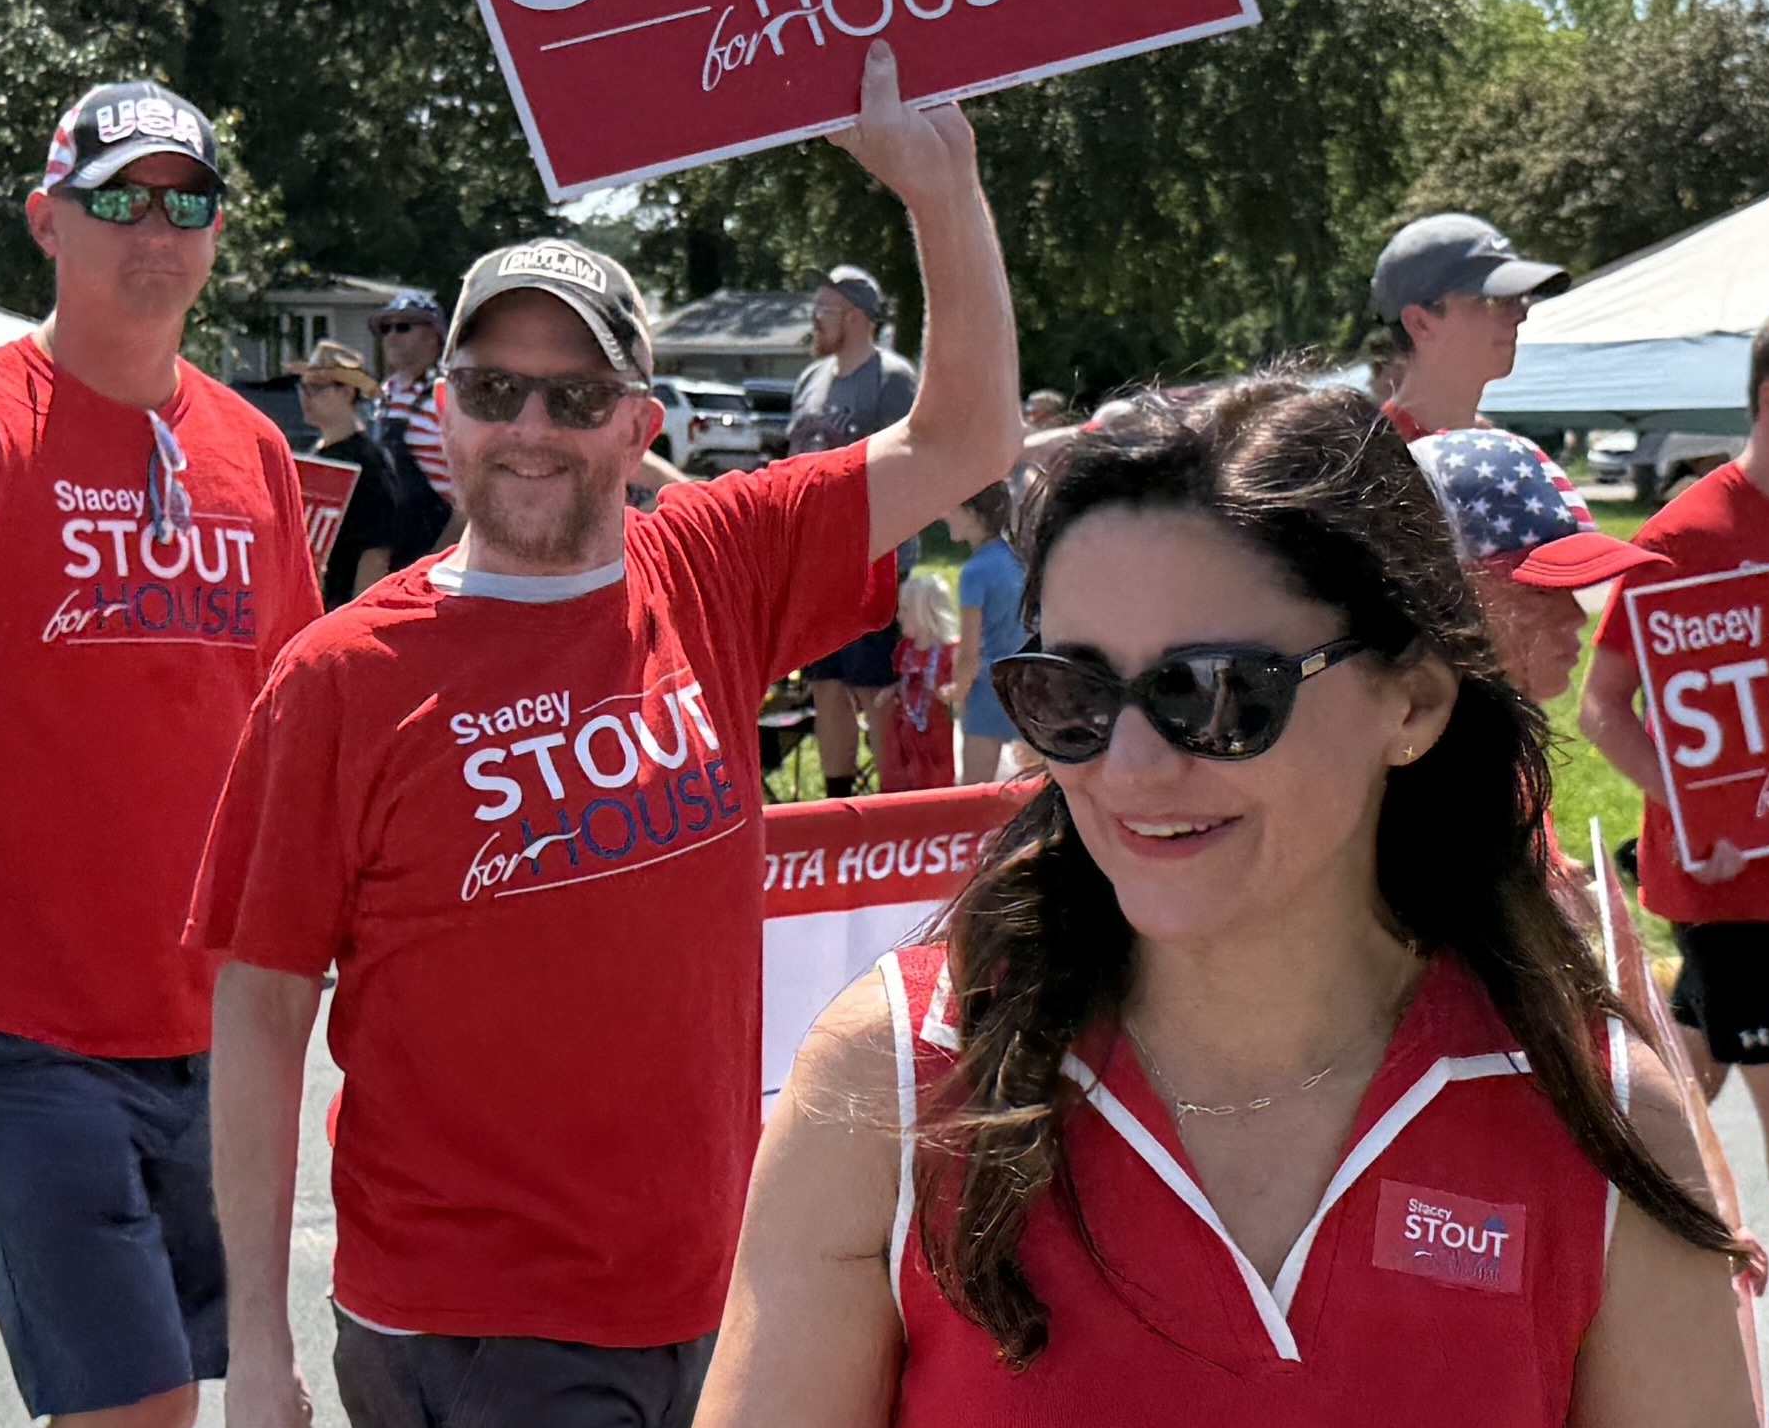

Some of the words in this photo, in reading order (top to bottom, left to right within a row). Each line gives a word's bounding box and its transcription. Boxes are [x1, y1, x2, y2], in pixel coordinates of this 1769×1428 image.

[702, 5, 810, 92] for
[96, 97, 204, 156] USA
[54, 480, 145, 518] Stacey
[62, 518, 255, 586] STOUT
[42, 589, 120, 643] for
[94, 582, 256, 637] HOUSE
[1648, 605, 1762, 655] Stacey
[450, 690, 570, 745] Stacey
[463, 680, 720, 821] STOUT
[461, 831, 572, 902] for
[520, 758, 742, 876] HOUSE
[836, 831, 976, 885] HOUSE
[1404, 1214, 1510, 1258] STOUT
